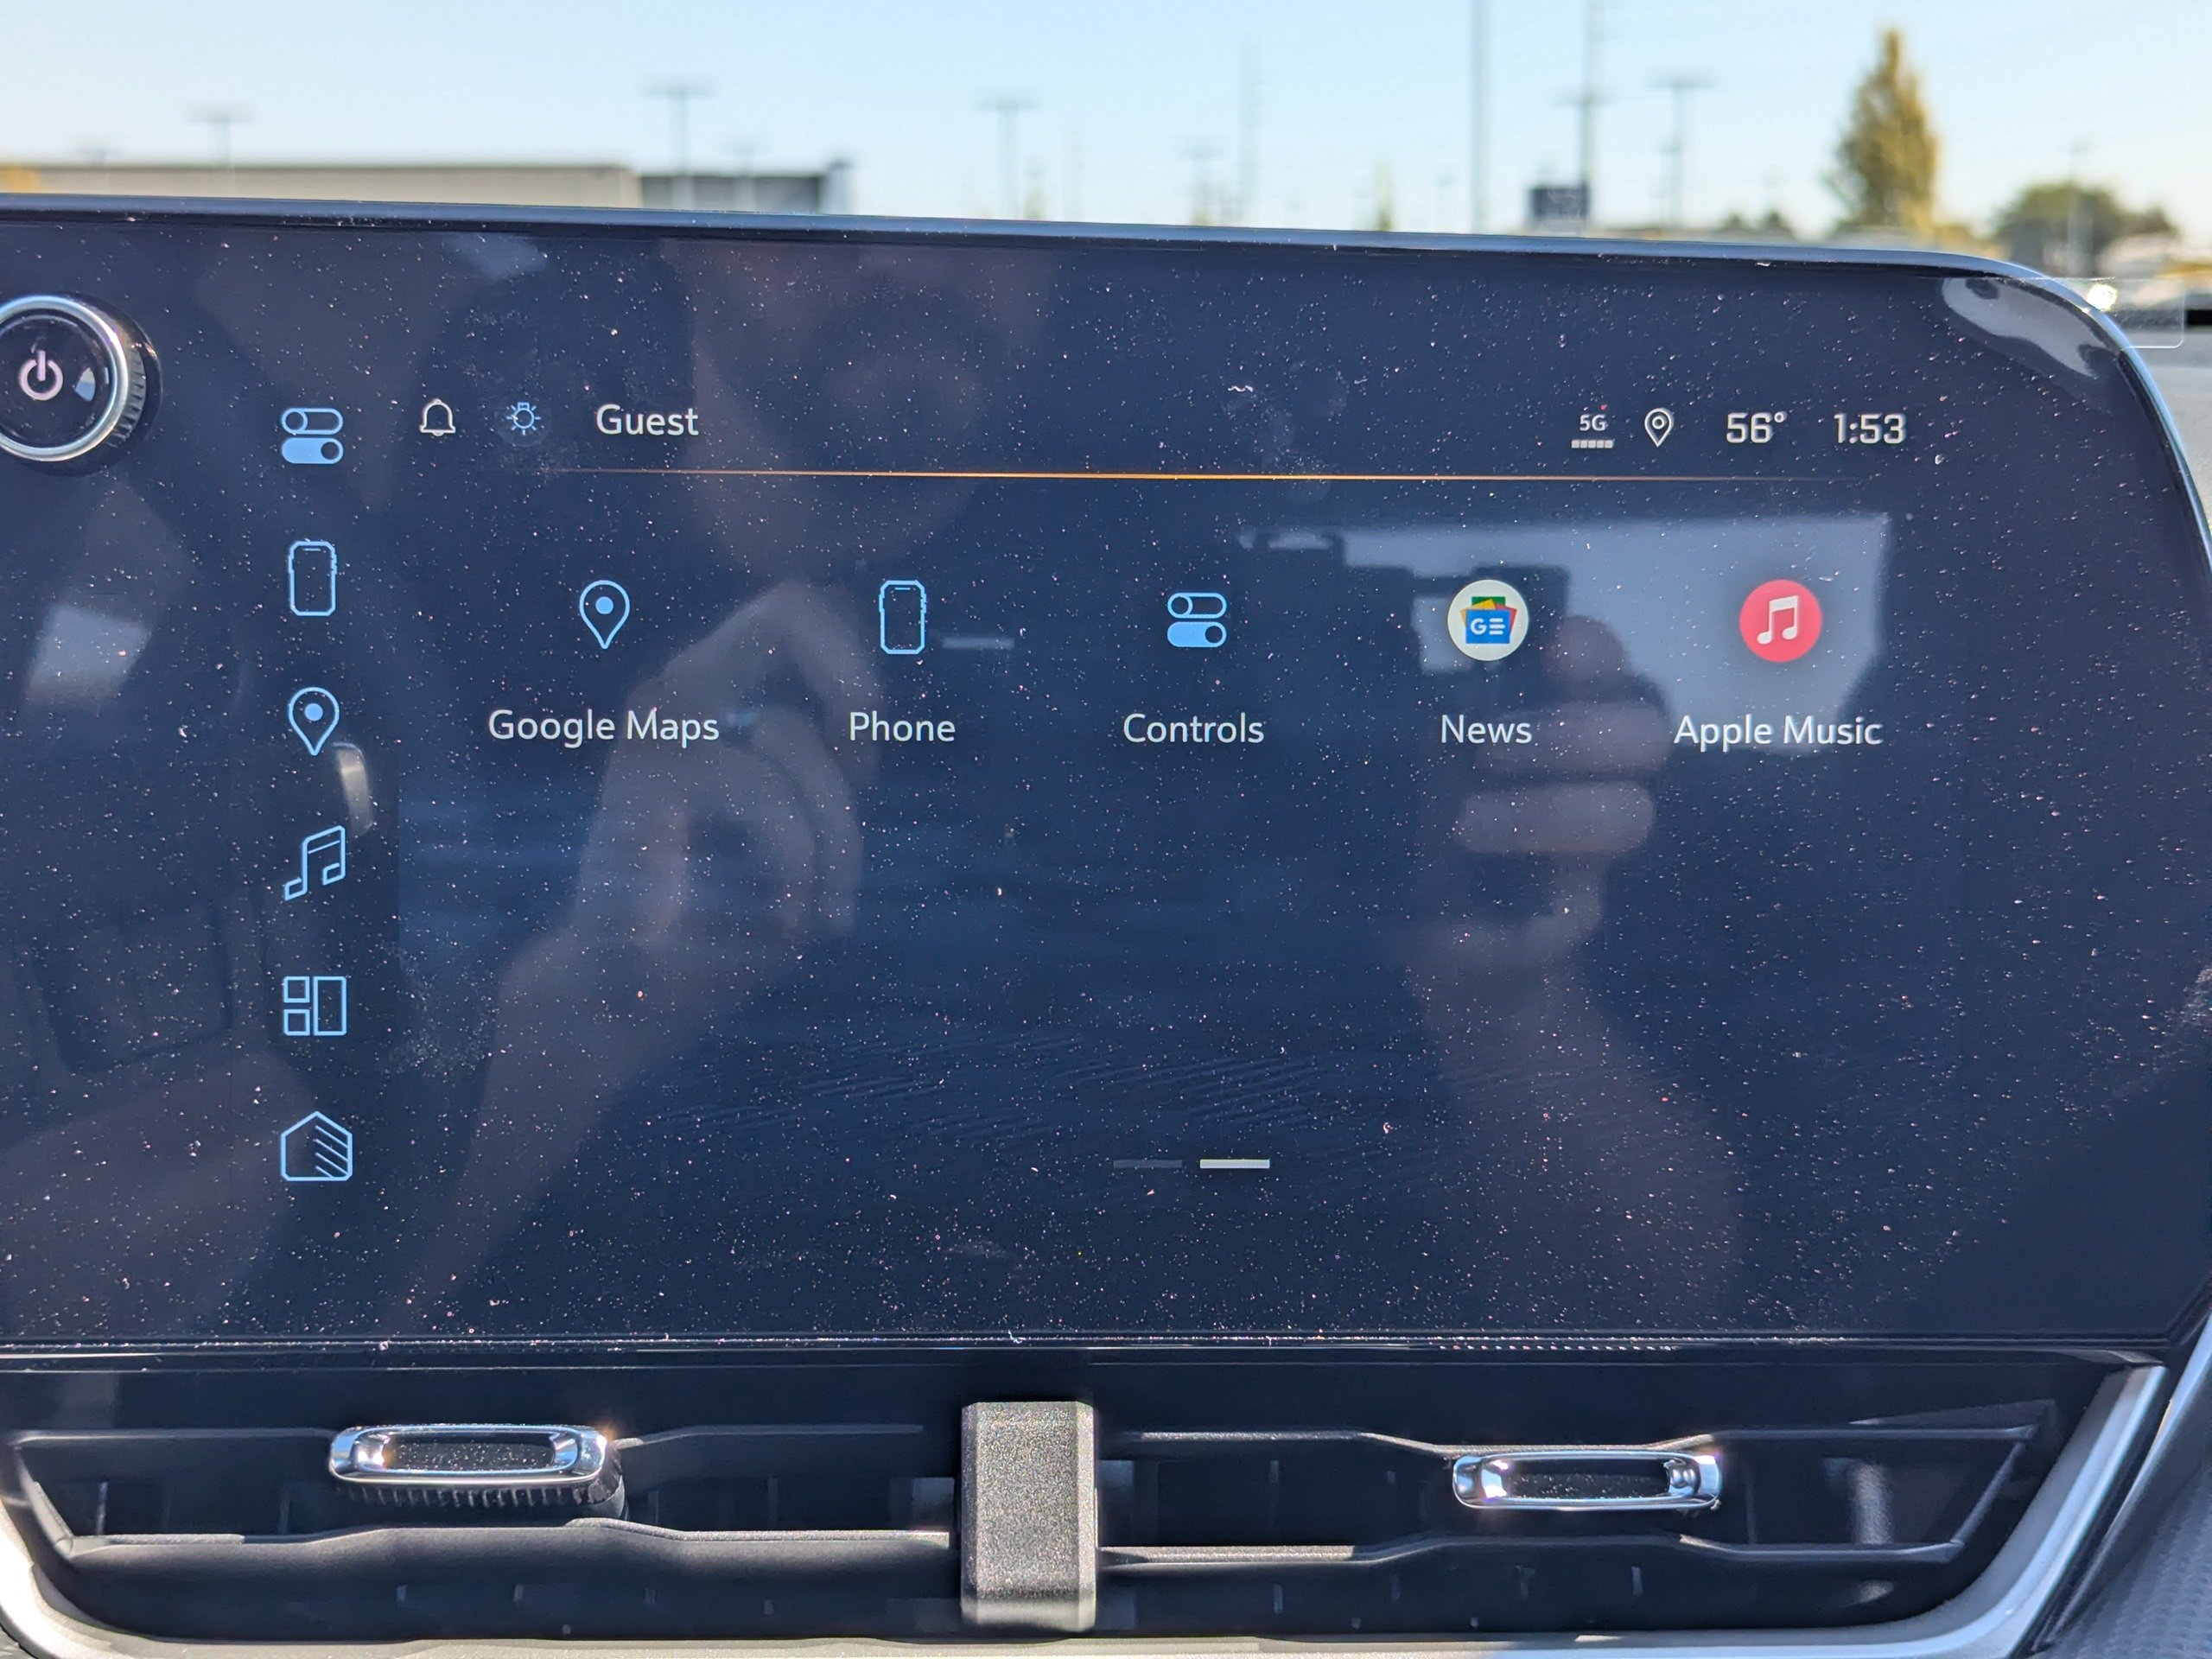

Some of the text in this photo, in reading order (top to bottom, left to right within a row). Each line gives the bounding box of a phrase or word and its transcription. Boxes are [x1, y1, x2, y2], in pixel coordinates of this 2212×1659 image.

[596, 404, 699, 436] Guest
[1580, 414, 1607, 431] 5G
[1726, 410, 1788, 445] 56°
[1834, 412, 1908, 445] 1:53
[488, 709, 720, 749] Google Maps
[849, 712, 957, 743] Phone
[1123, 713, 1265, 745] Controls
[1440, 715, 1533, 745] News
[1675, 714, 1884, 753] Apple Music
